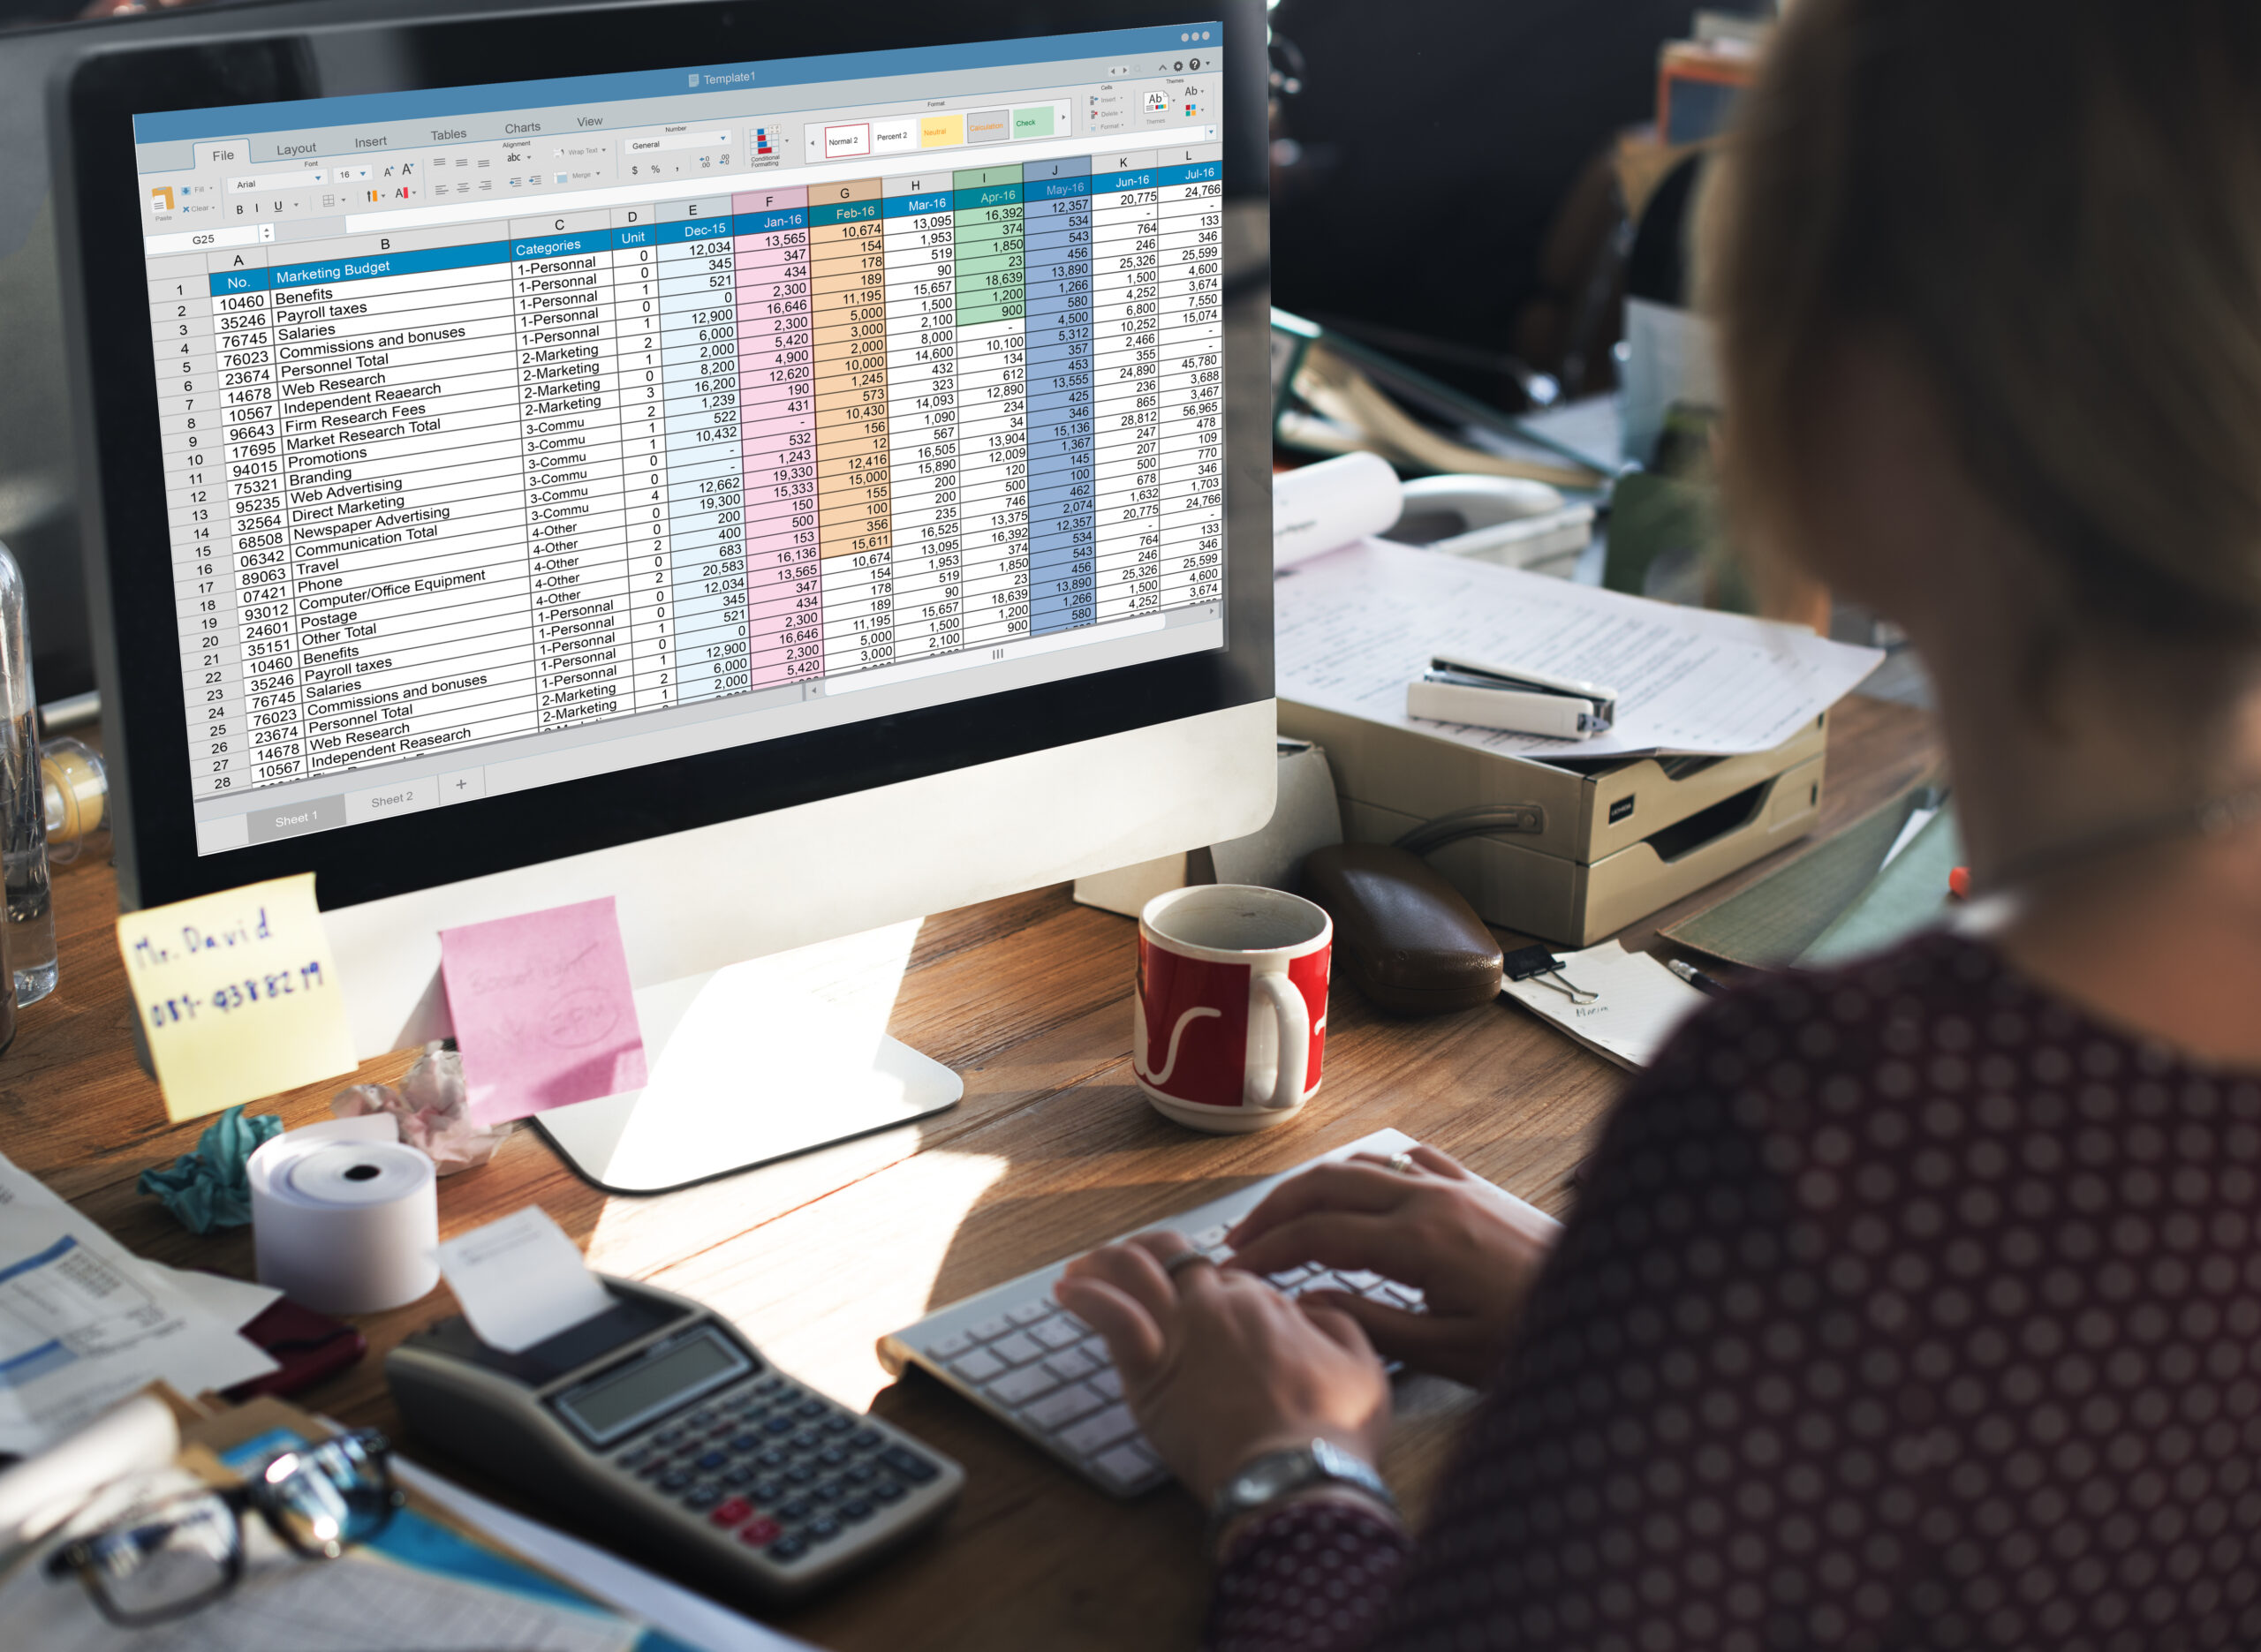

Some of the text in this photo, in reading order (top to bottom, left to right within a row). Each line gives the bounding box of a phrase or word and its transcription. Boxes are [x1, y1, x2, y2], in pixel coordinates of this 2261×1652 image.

[703, 71, 755, 86] Template1
[1184, 86, 1198, 96] Ab
[1148, 94, 1162, 104] Ab
[504, 122, 541, 134] Charts
[577, 117, 603, 127] View
[967, 122, 1004, 133] Calculation
[430, 129, 467, 141] Tables
[877, 132, 902, 141] Percent
[924, 128, 947, 137] Neutral
[355, 136, 388, 148] Insert
[631, 140, 660, 150] General
[828, 137, 852, 146] Normal
[213, 150, 234, 162] File
[276, 142, 317, 157] Layout
[507, 152, 521, 162] abc
[1185, 150, 1192, 161] L
[651, 164, 661, 174] %
[1120, 157, 1128, 168] K
[631, 165, 639, 176] $
[983, 172, 986, 184] I
[1052, 165, 1058, 176] J
[1184, 167, 1214, 180] Jul-16
[237, 180, 256, 189] Arial
[911, 180, 920, 191] H
[1047, 182, 1085, 196] May-16
[1115, 175, 1150, 188] Jun-16
[840, 187, 850, 199] G
[980, 190, 1016, 205] Apr-16
[274, 200, 283, 211] U
[766, 196, 774, 207] F
[909, 198, 947, 212] Mar-16
[236, 205, 244, 215] B
[628, 211, 638, 223] D
[689, 204, 698, 216] E
[836, 206, 875, 220] Feb-16
[985, 207, 1023, 222] 16,392
[555, 219, 565, 230] C
[764, 214, 802, 229] Jan-16
[622, 231, 645, 244] Unit
[684, 223, 726, 238] Dec-15
[920, 228, 952, 246] 1,953
[192, 234, 215, 245] G25
[381, 238, 390, 250] B
[516, 240, 581, 256] Categories
[689, 240, 731, 256] 12,034
[1067, 246, 1088, 259] 456
[233, 254, 245, 267] A
[518, 255, 596, 276] 1-Personnal
[1119, 254, 1156, 269] 25,326
[276, 260, 390, 283] Marketing Budget
[783, 262, 808, 278] 434
[228, 277, 251, 289] No.
[1189, 277, 1218, 292] 3,674
[220, 294, 264, 312] 10460
[275, 289, 334, 306] Benefits
[843, 289, 882, 306] 11,195
[276, 303, 368, 323] Payroll taxes
[278, 325, 337, 341] Salaries
[279, 328, 466, 359] Commissions and bonuses
[522, 345, 599, 365] 2-Marketing
[1181, 353, 1220, 369] 45,780
[281, 352, 389, 378] Personnel Total
[225, 368, 270, 386] 23674
[1002, 366, 1024, 381] 612
[1052, 373, 1089, 389] 13,555
[282, 372, 386, 396] Web Research
[694, 376, 736, 393] 16,200
[284, 382, 442, 415] Independent Reaearch
[285, 404, 427, 434] Firm Research Fees
[845, 404, 885, 420] 10,430
[1121, 411, 1157, 426] 28,812
[286, 418, 441, 451] Market Research Total
[526, 419, 585, 435] 3-Commu
[232, 441, 276, 459] 17695
[778, 446, 816, 465] 1,243
[918, 442, 957, 459] 16,505
[288, 449, 367, 469] Promotions
[289, 468, 352, 487] Branding
[290, 479, 403, 504] Web Advertising
[292, 496, 405, 523] Direct Marketing
[991, 508, 1028, 526] 13,375
[237, 514, 282, 532] 32564
[293, 507, 450, 540] Newspaper Advertising
[532, 523, 578, 538] 4-Other
[1056, 516, 1093, 532] 12,357
[294, 524, 438, 558] Communication Total
[1138, 549, 1158, 562] 246
[1183, 553, 1218, 570] 25,599
[295, 557, 339, 576] Travel
[702, 559, 745, 577] 20,583
[298, 577, 344, 593] Phone
[299, 569, 487, 611] Computer/Office Equipment
[871, 582, 892, 596] 178
[243, 585, 286, 604] 07421
[300, 611, 358, 630] Postage
[929, 617, 960, 633] 1,500
[301, 622, 377, 646] Other Total
[779, 628, 819, 645] 16,646
[250, 673, 295, 692] 35246
[254, 726, 299, 744] 23674
[371, 791, 413, 808] Sheet 2
[276, 811, 317, 827] Sheet 1
[183, 907, 271, 954] David
